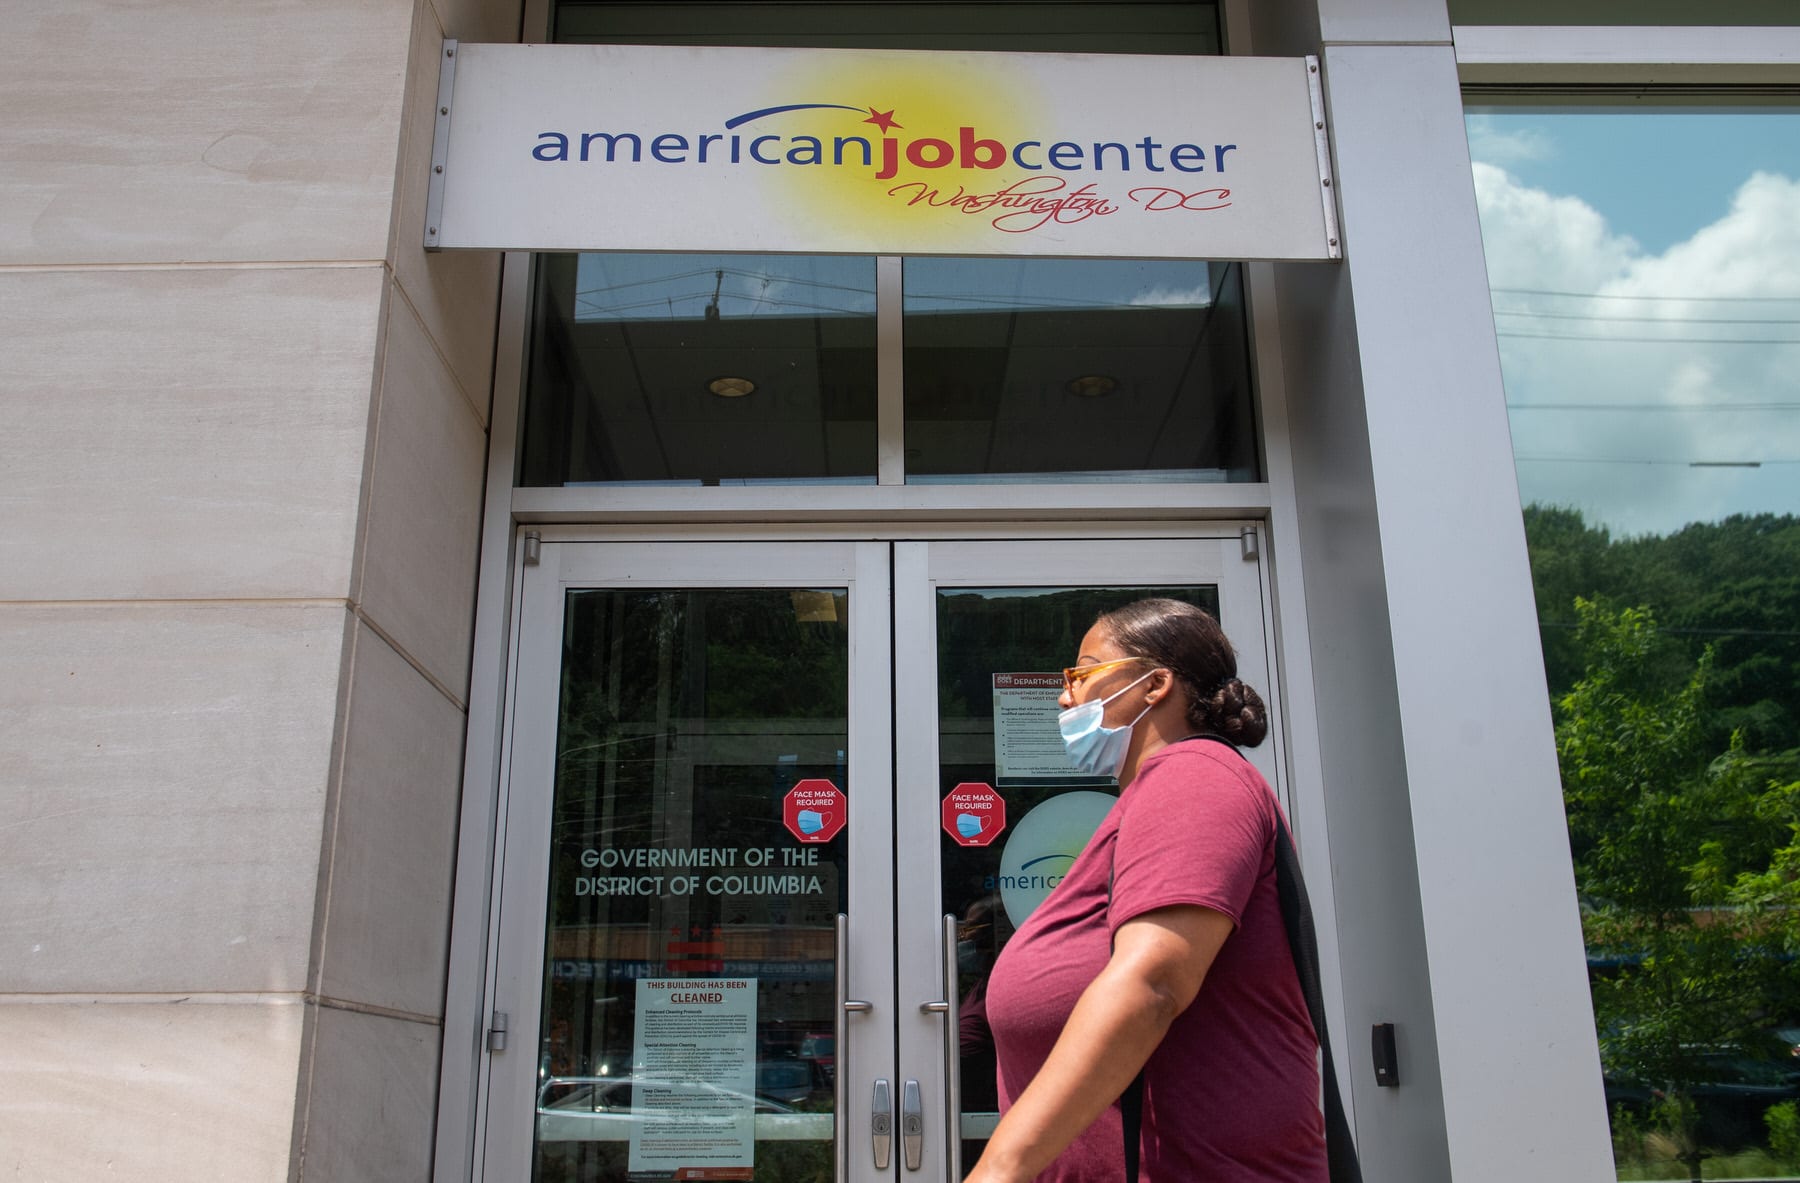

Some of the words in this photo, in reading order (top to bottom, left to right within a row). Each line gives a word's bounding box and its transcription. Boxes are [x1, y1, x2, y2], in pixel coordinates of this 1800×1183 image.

[1127, 186, 1233, 211] DC
[1013, 678, 1063, 686] DEPARTMENT
[580, 847, 738, 868] GOVERNMENT
[744, 847, 775, 867] OF
[781, 847, 819, 867] THE
[575, 876, 665, 896] DISTRICT
[669, 875, 700, 896] OF
[705, 875, 823, 895] COLUMBIA
[647, 981, 665, 989] THIS
[667, 981, 706, 989] BUILDING
[707, 981, 725, 989] HAS
[670, 993, 723, 1003] CLEANED
